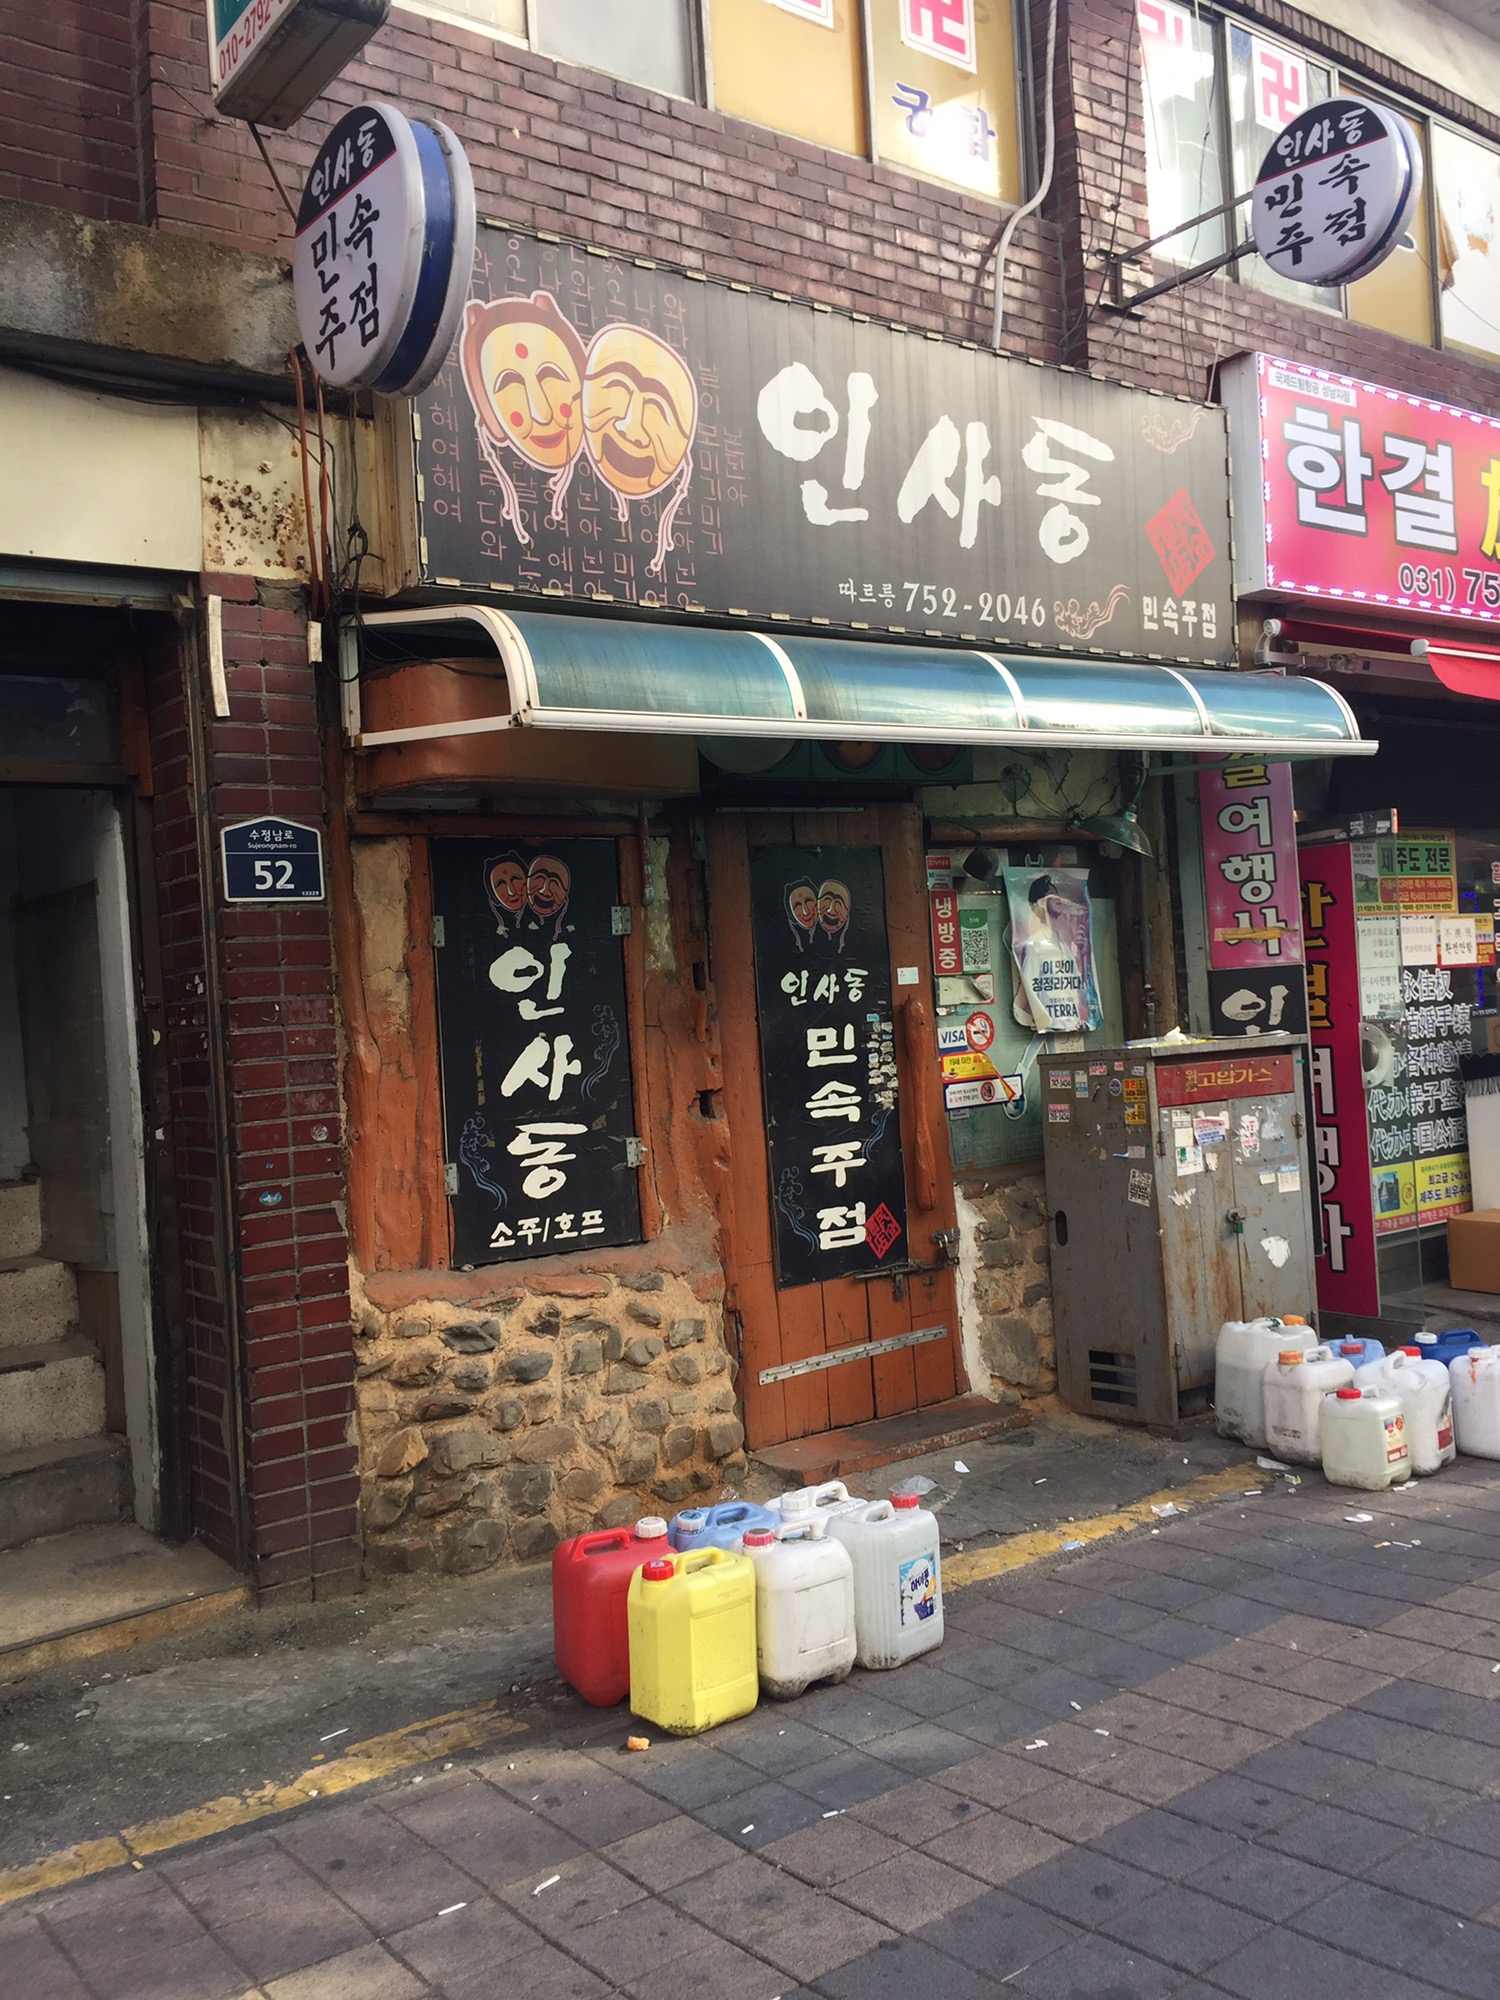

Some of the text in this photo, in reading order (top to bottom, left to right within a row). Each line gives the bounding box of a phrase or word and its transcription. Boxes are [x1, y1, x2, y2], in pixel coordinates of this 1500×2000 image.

[1275, 107, 1370, 164] 인사동
[309, 118, 378, 204] 인사동
[1264, 153, 1371, 218] 민속
[310, 194, 381, 294] 민속
[1265, 198, 1368, 268] 주점
[314, 264, 382, 370] 주점
[757, 361, 1116, 565] 인사동
[1282, 405, 1459, 553] 한결
[1398, 562, 1456, 601] 031)
[838, 578, 1046, 628] 따르릉 752-2046
[1142, 595, 1217, 640] 민속주점
[247, 841, 298, 850] Sujeongnam-ro
[249, 829, 294, 842] 수정남로
[254, 860, 295, 890] 52
[1381, 846, 1420, 873] 제주도
[1425, 846, 1450, 873] 전문
[935, 896, 957, 970] 냉방중
[780, 967, 868, 1007] 인사동
[1032, 976, 1085, 992] 청정라거다!
[1043, 960, 1074, 975] 이 맛이
[1046, 1003, 1079, 1018] TERRA
[941, 1030, 966, 1044] VISA
[489, 943, 588, 1199] 인사동
[1197, 1067, 1273, 1088] 고압가스
[805, 1024, 869, 1252] 민속주점
[1420, 1189, 1443, 1204] 제주도
[1428, 1172, 1449, 1185] 최고급
[489, 1210, 606, 1248] 소주/호프
